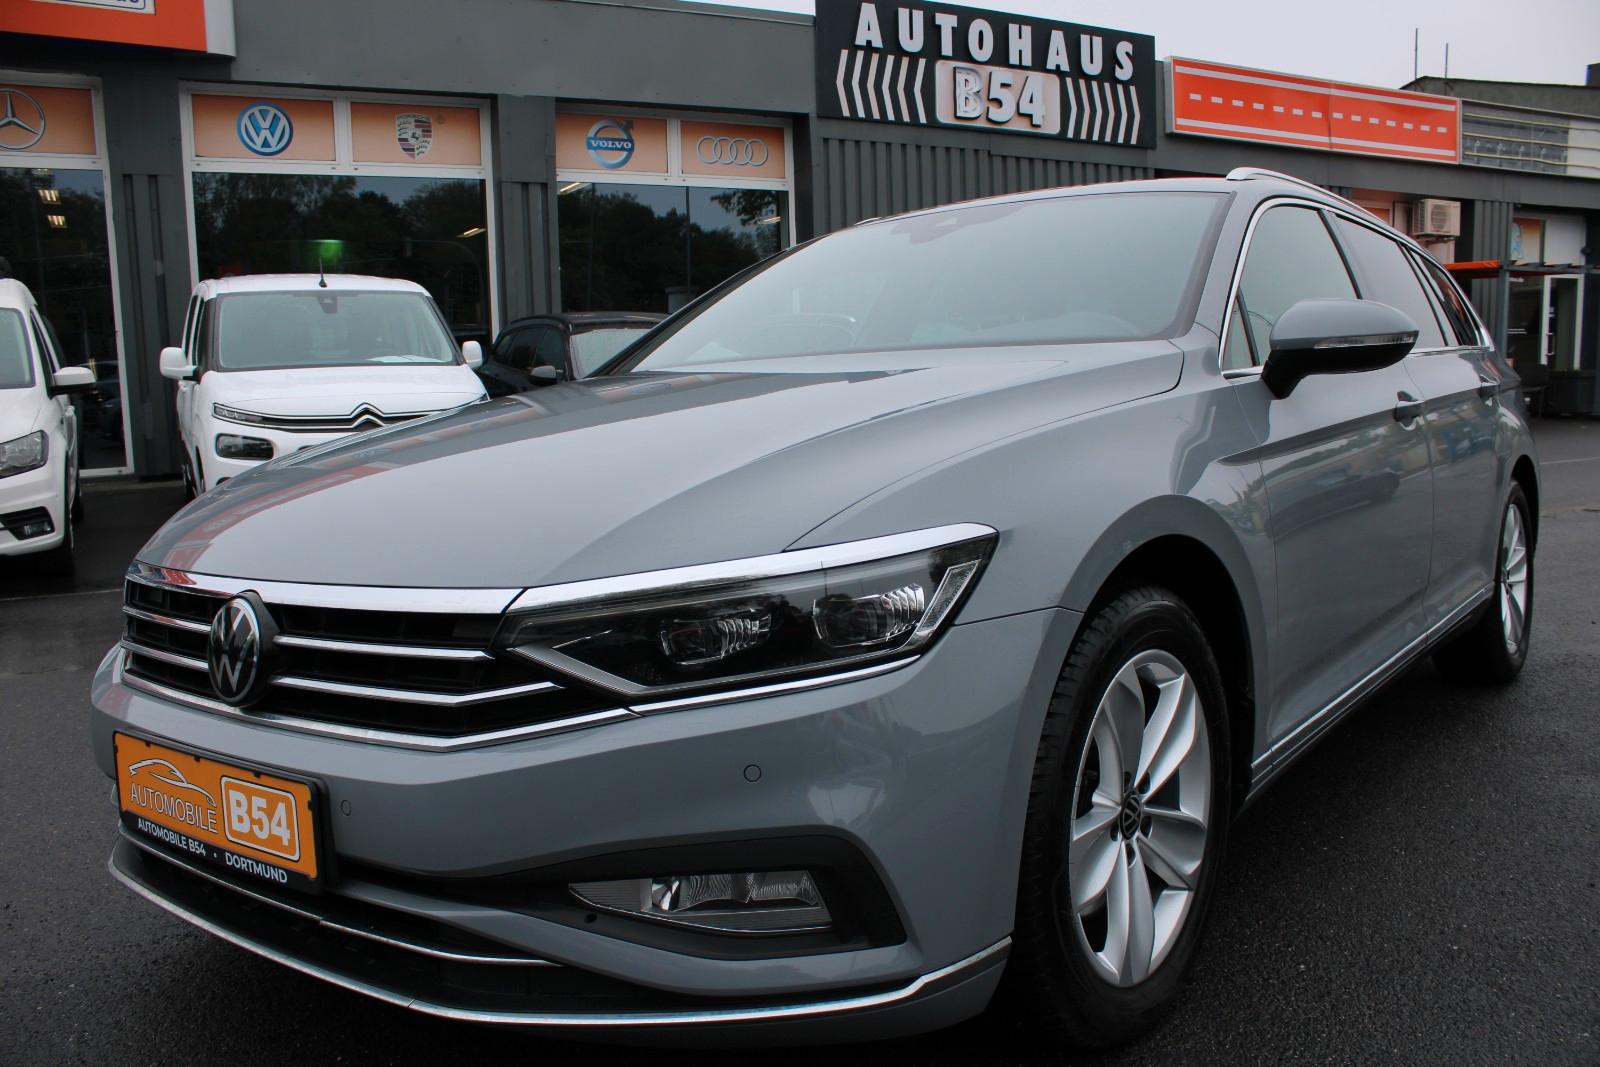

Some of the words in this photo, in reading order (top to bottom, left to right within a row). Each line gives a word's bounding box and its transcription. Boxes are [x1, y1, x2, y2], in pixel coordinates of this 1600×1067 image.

[855, 2, 1134, 81] AUTOHAUS
[953, 65, 1047, 127] B54
[590, 139, 632, 150] VOLVO
[130, 782, 219, 834] AUTOMOBILE
[228, 789, 291, 846] B54
[137, 817, 188, 850] AUTOMOBILE
[188, 841, 207, 858] B54
[225, 851, 288, 884] DORTMUND
